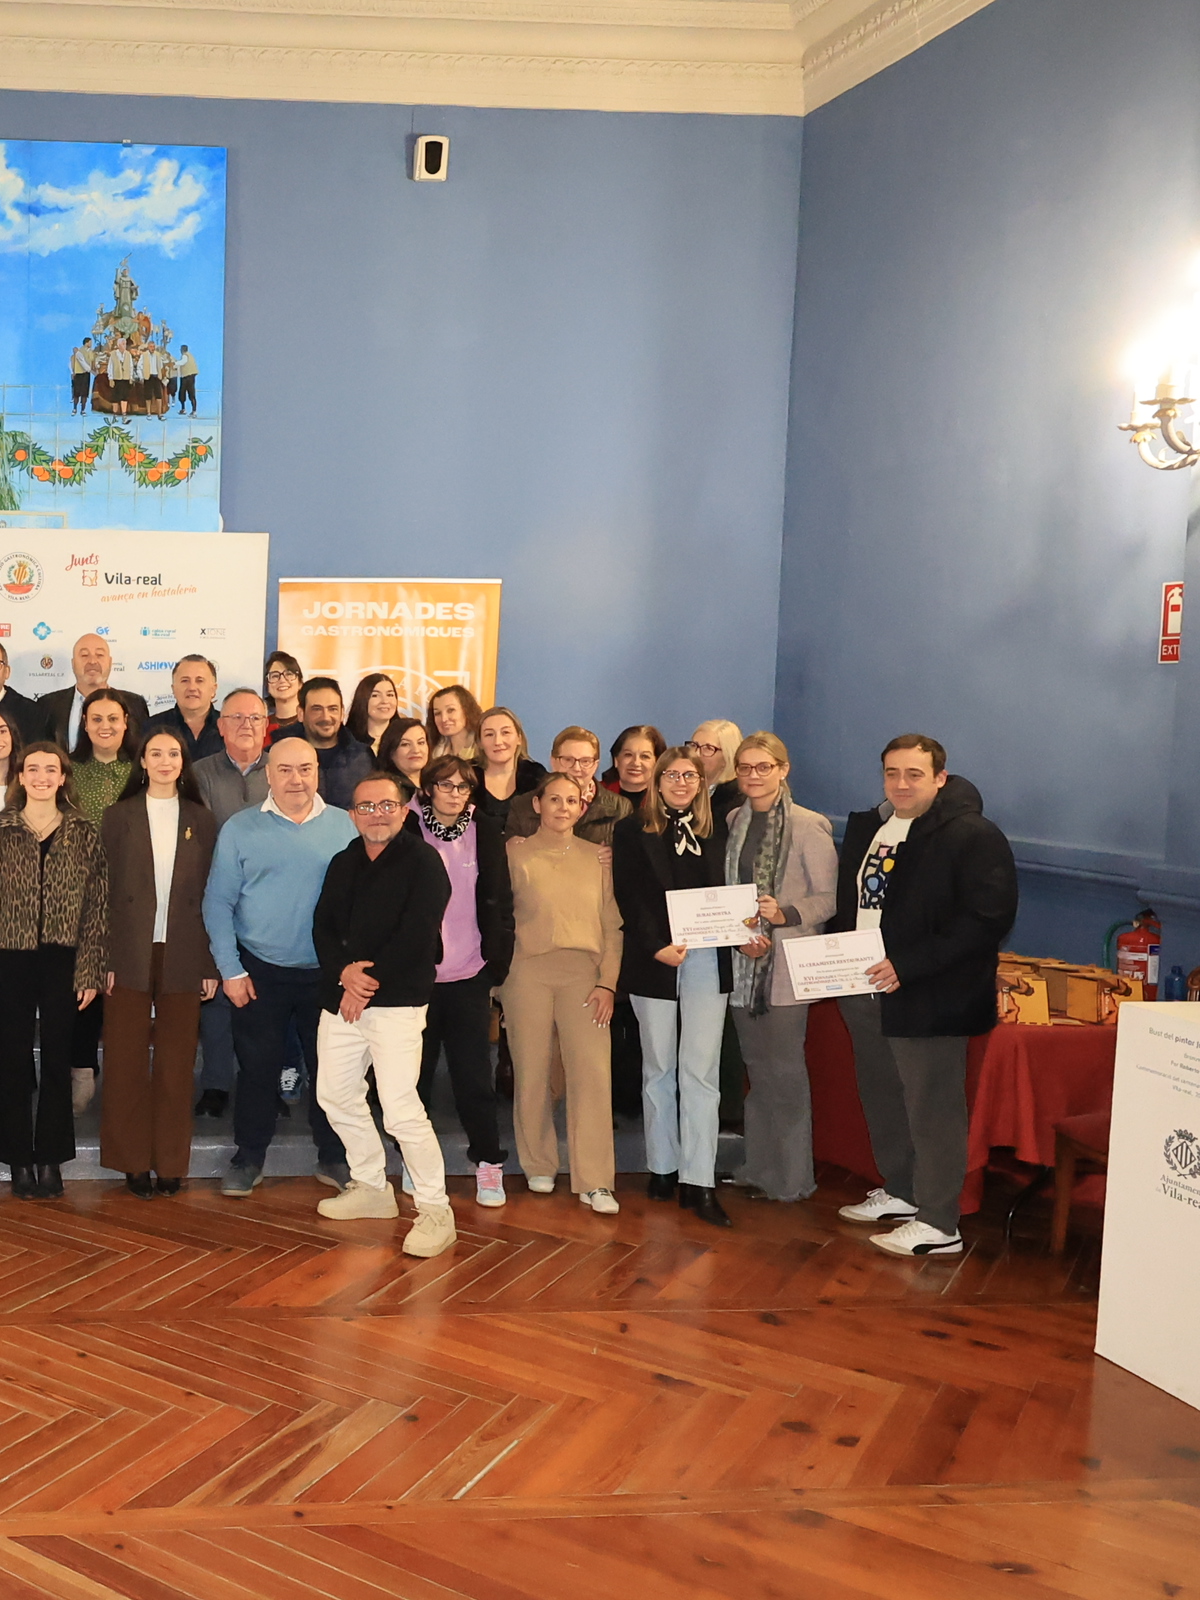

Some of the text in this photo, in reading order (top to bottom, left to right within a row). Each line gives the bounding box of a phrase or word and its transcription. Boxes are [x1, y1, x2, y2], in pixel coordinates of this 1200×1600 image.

[65, 553, 100, 571] Junts
[104, 572, 162, 586] Vila-real
[100, 592, 134, 603] avança
[150, 584, 197, 598] hostaleria
[302, 601, 475, 620] JORNADES
[302, 623, 475, 638] GASTRONÒMIQUES
[1148, 1026, 1195, 1047] Bust del pintor
